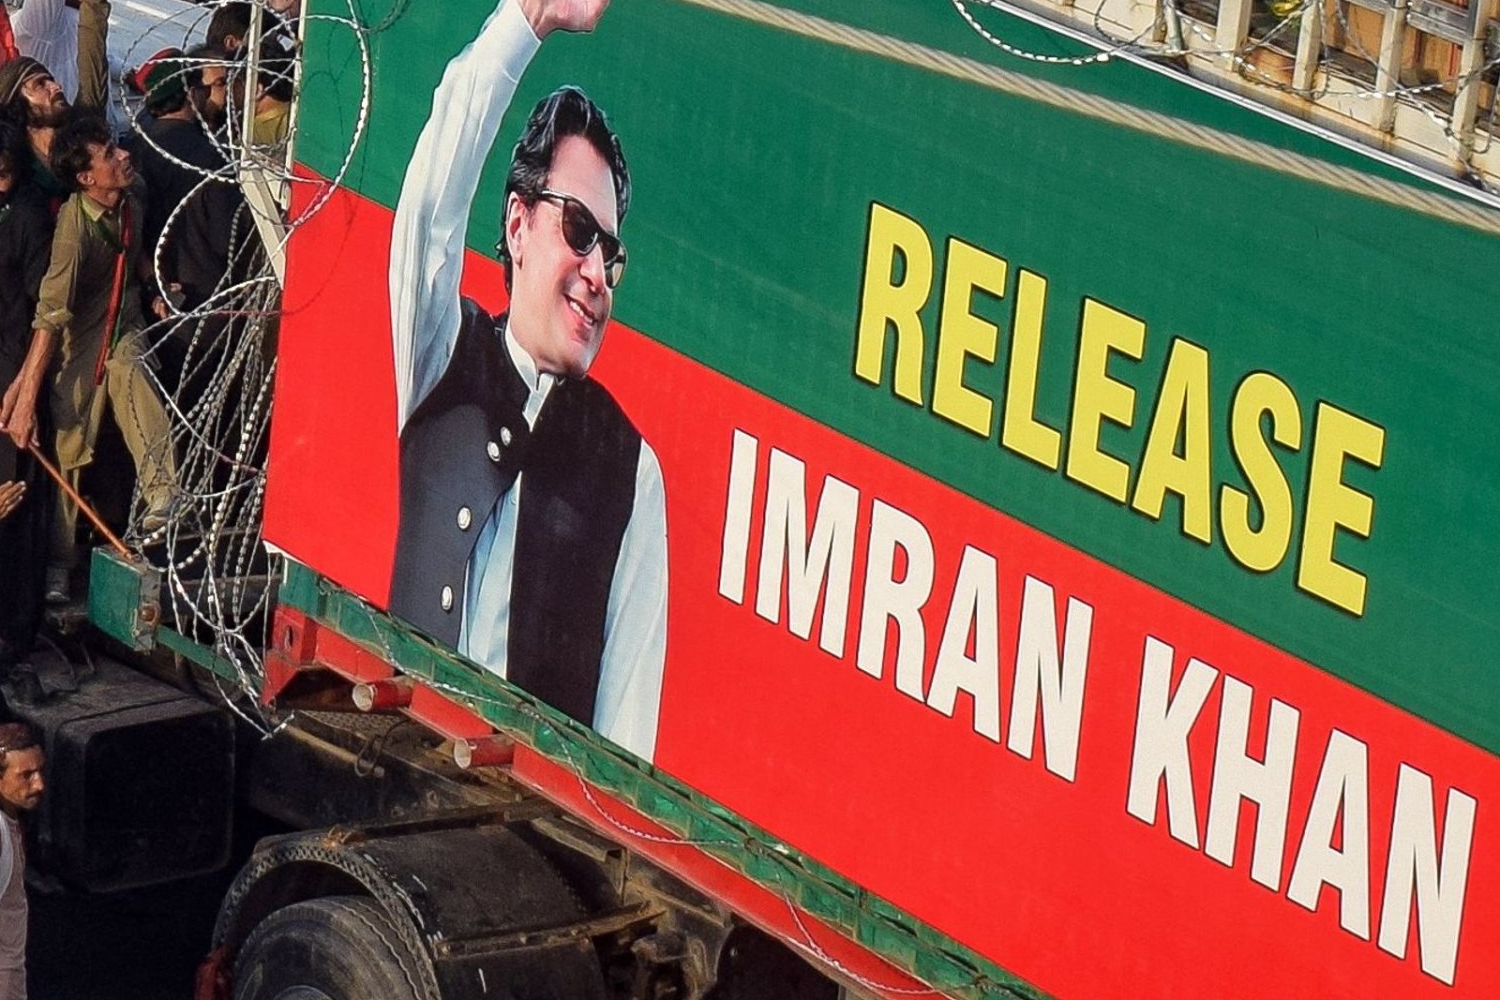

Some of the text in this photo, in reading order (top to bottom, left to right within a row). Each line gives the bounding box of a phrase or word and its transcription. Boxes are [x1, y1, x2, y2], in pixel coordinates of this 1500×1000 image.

[855, 201, 1386, 617] RELEASE
[717, 428, 1478, 988] IMRAN KHAN
